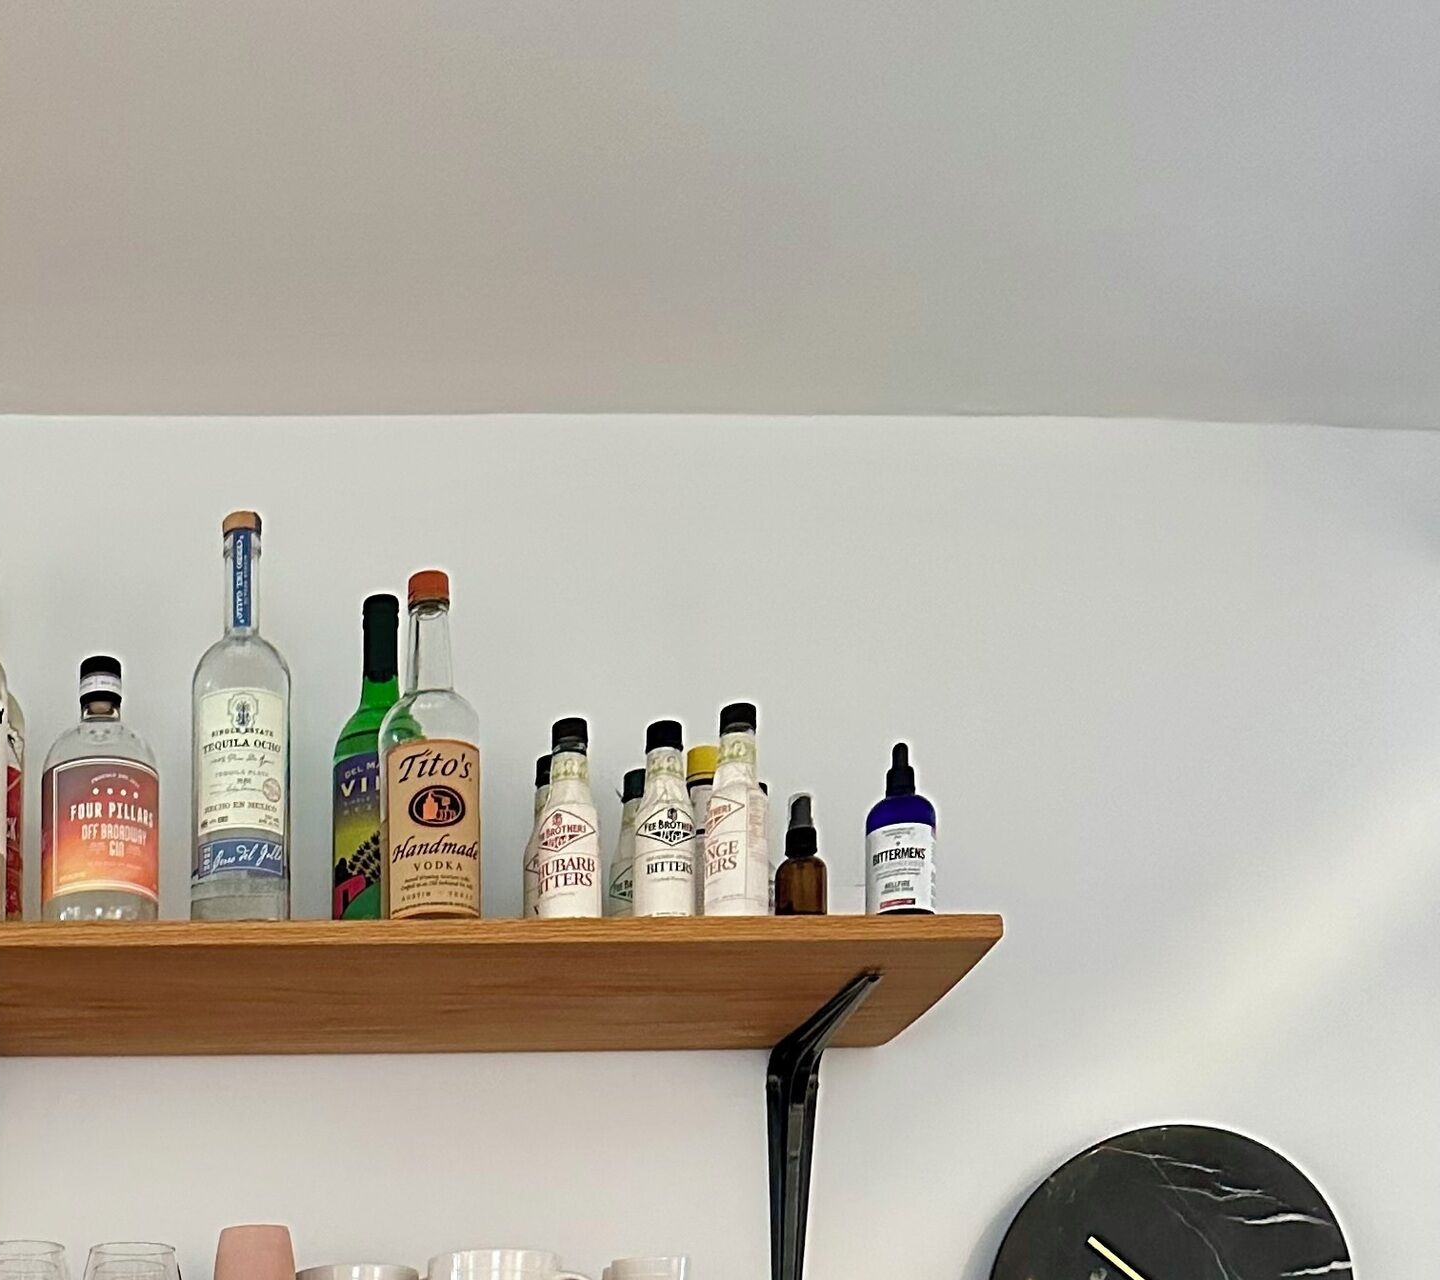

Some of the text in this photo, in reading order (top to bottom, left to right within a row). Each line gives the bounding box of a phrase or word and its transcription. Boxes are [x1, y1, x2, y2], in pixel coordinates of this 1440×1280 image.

[204, 738, 281, 754] TEQUILA OCHO
[345, 766, 364, 780] DEL
[398, 748, 472, 784] Tito's
[70, 801, 154, 829] FOUR PILLARS
[81, 823, 147, 846] OFF BROADWAY
[392, 833, 478, 864] Handmade
[872, 847, 927, 867] BITTERMENS
[414, 860, 463, 872] VODKA
[646, 860, 693, 875] BITTERS
